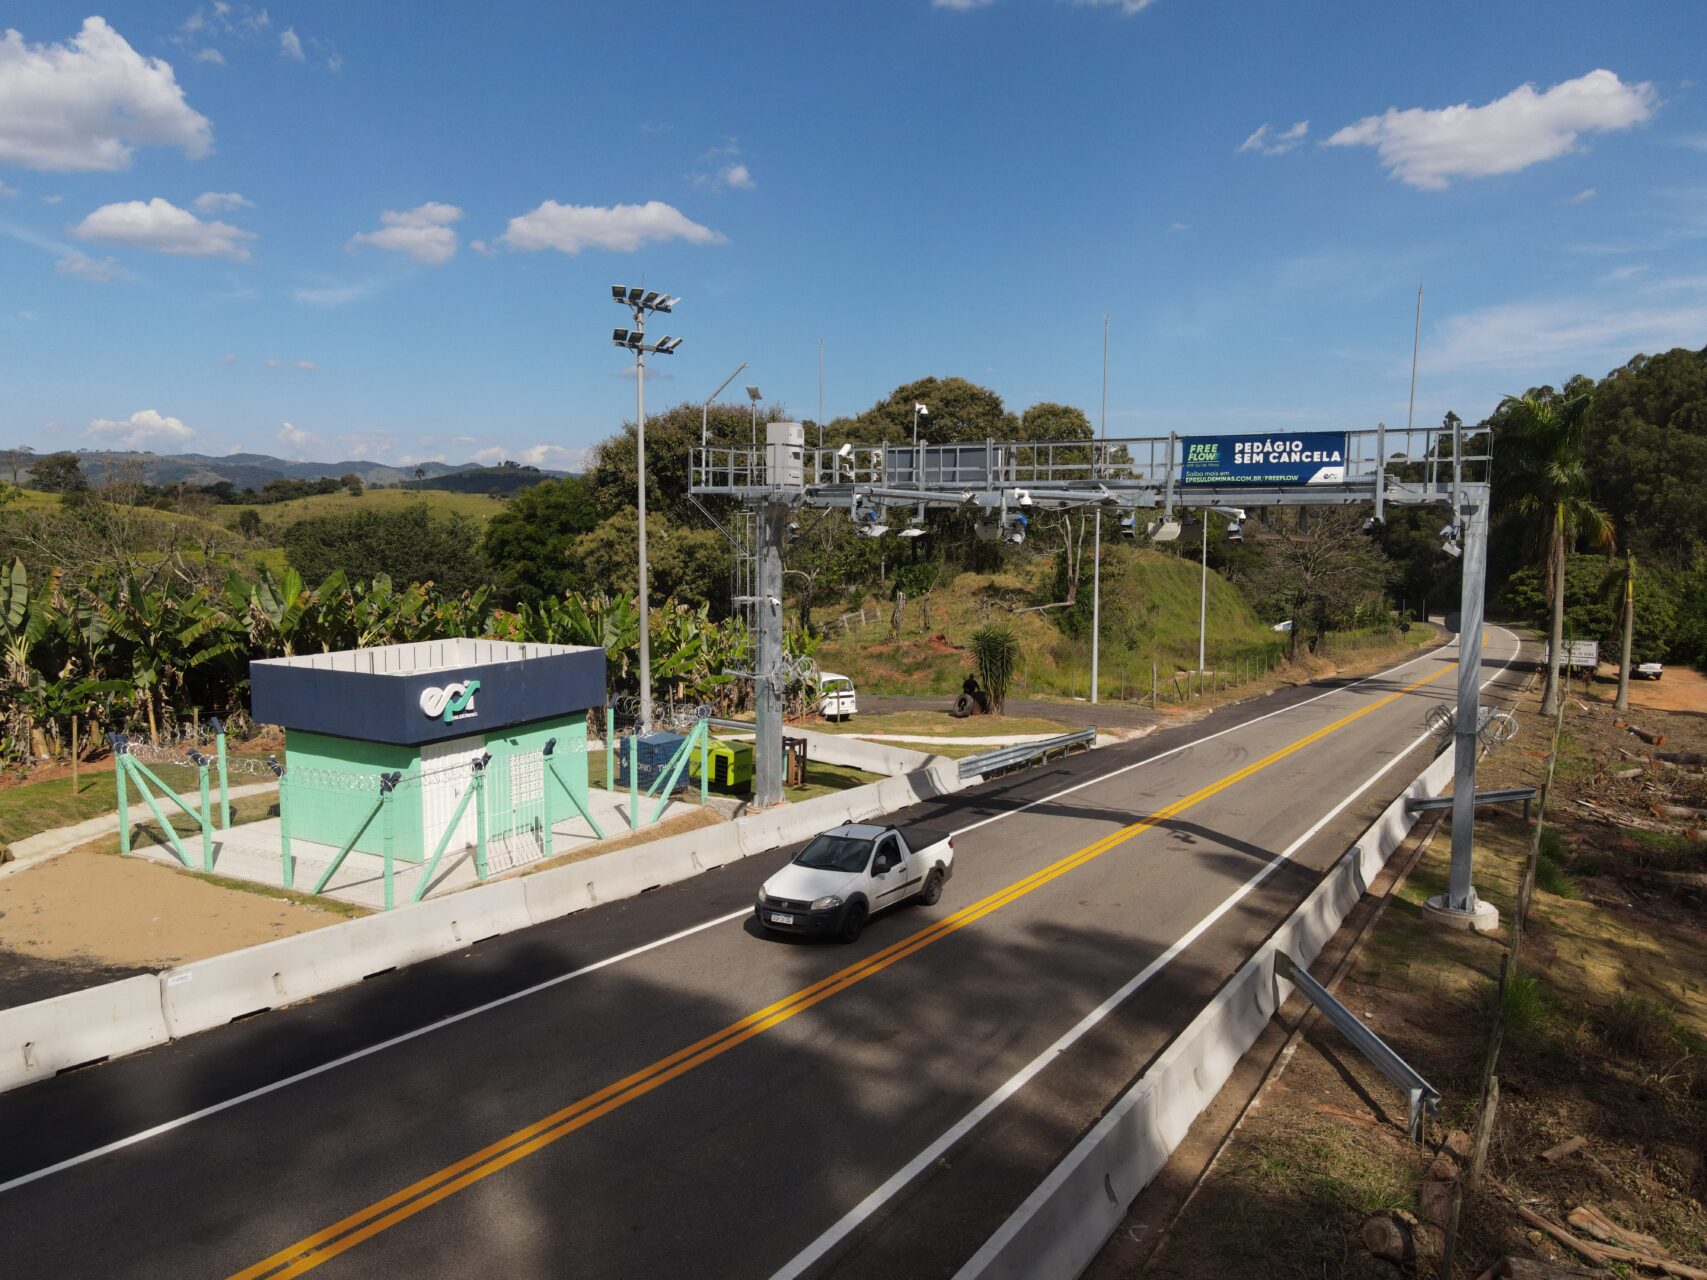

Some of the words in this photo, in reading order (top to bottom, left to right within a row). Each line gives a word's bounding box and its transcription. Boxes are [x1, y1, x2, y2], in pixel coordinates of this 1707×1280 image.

[1190, 444, 1218, 453] FREE
[1235, 439, 1303, 453] PEDÁGIO
[1188, 453, 1217, 461] FLOW
[1234, 453, 1264, 464] SEM
[1269, 451, 1341, 463] CANCELA
